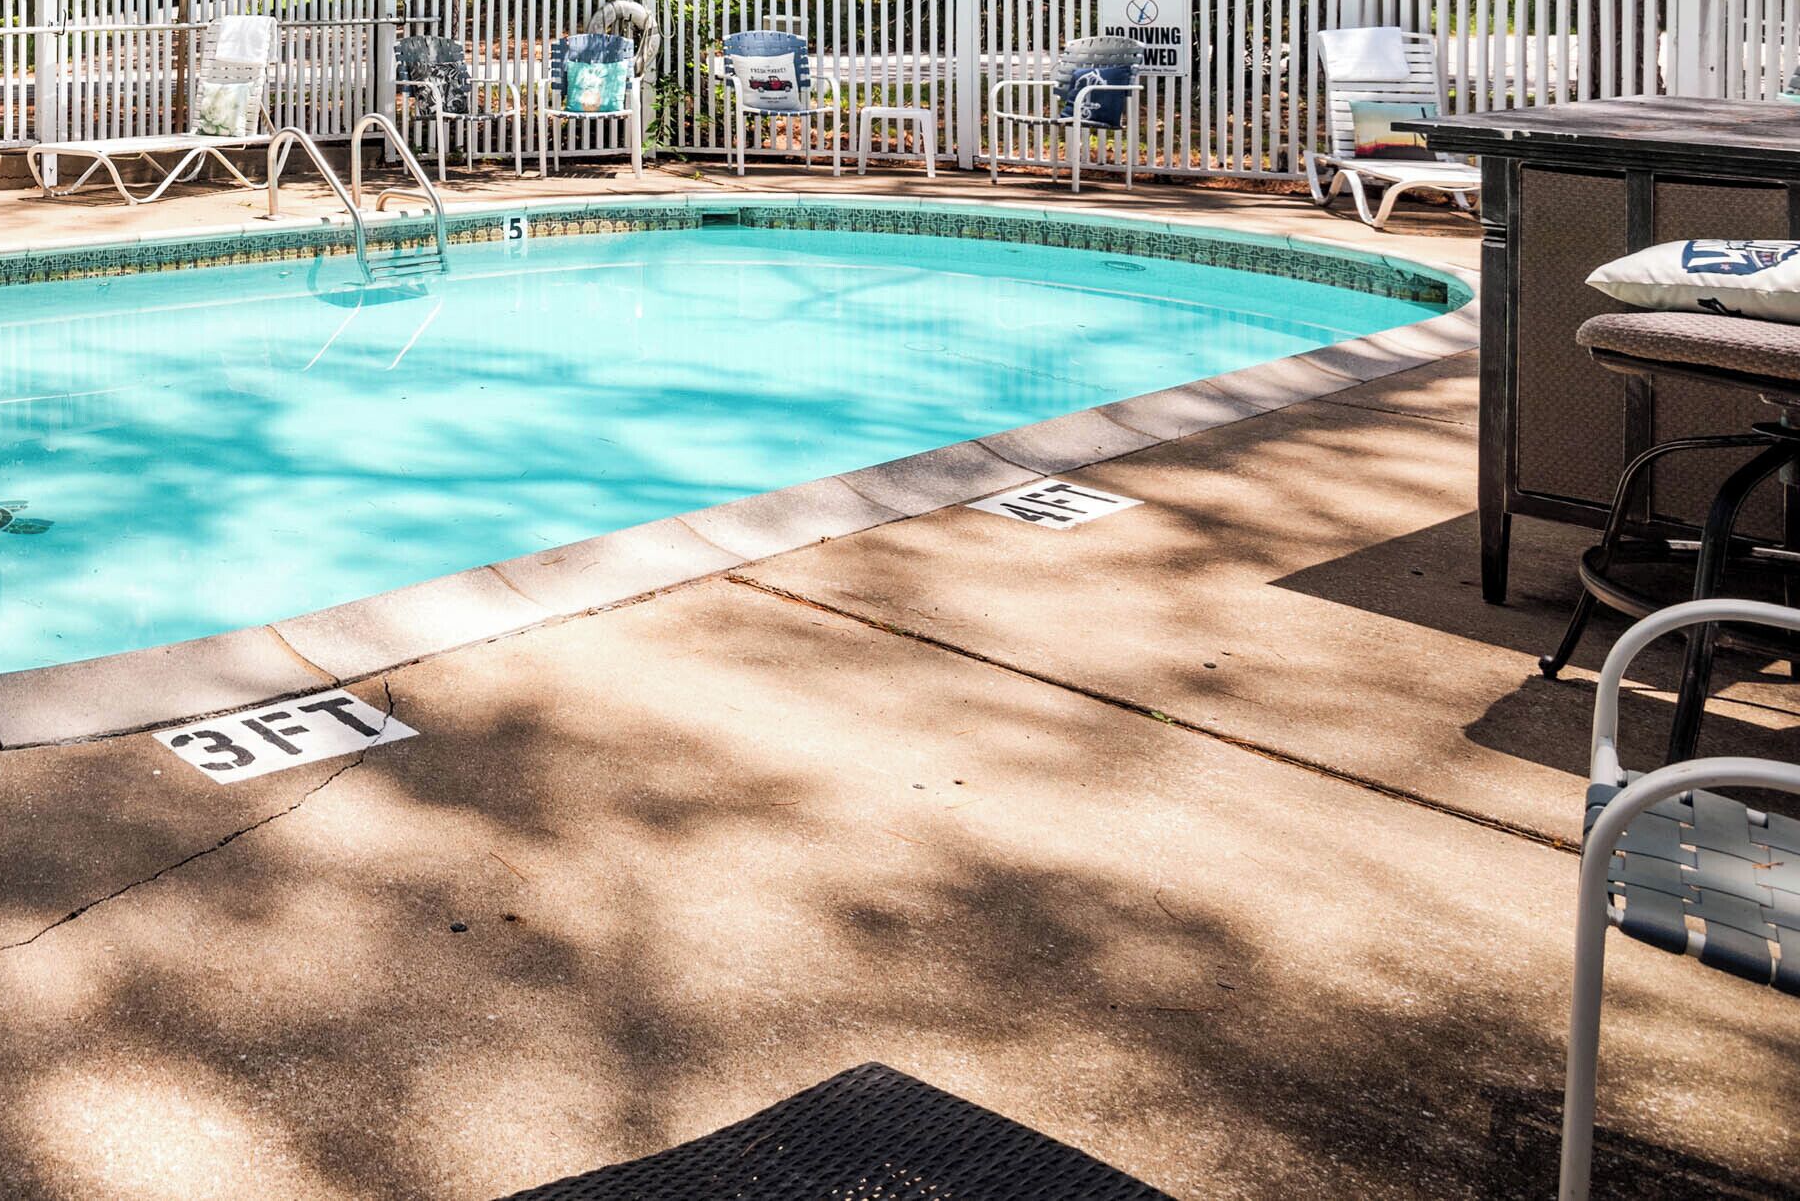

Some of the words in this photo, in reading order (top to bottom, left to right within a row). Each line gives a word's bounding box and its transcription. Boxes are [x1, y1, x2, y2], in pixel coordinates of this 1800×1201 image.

[1129, 27, 1181, 44] DIVING
[509, 217, 523, 239] 5
[999, 483, 1119, 522] 4FT
[170, 697, 381, 771] 3FT
